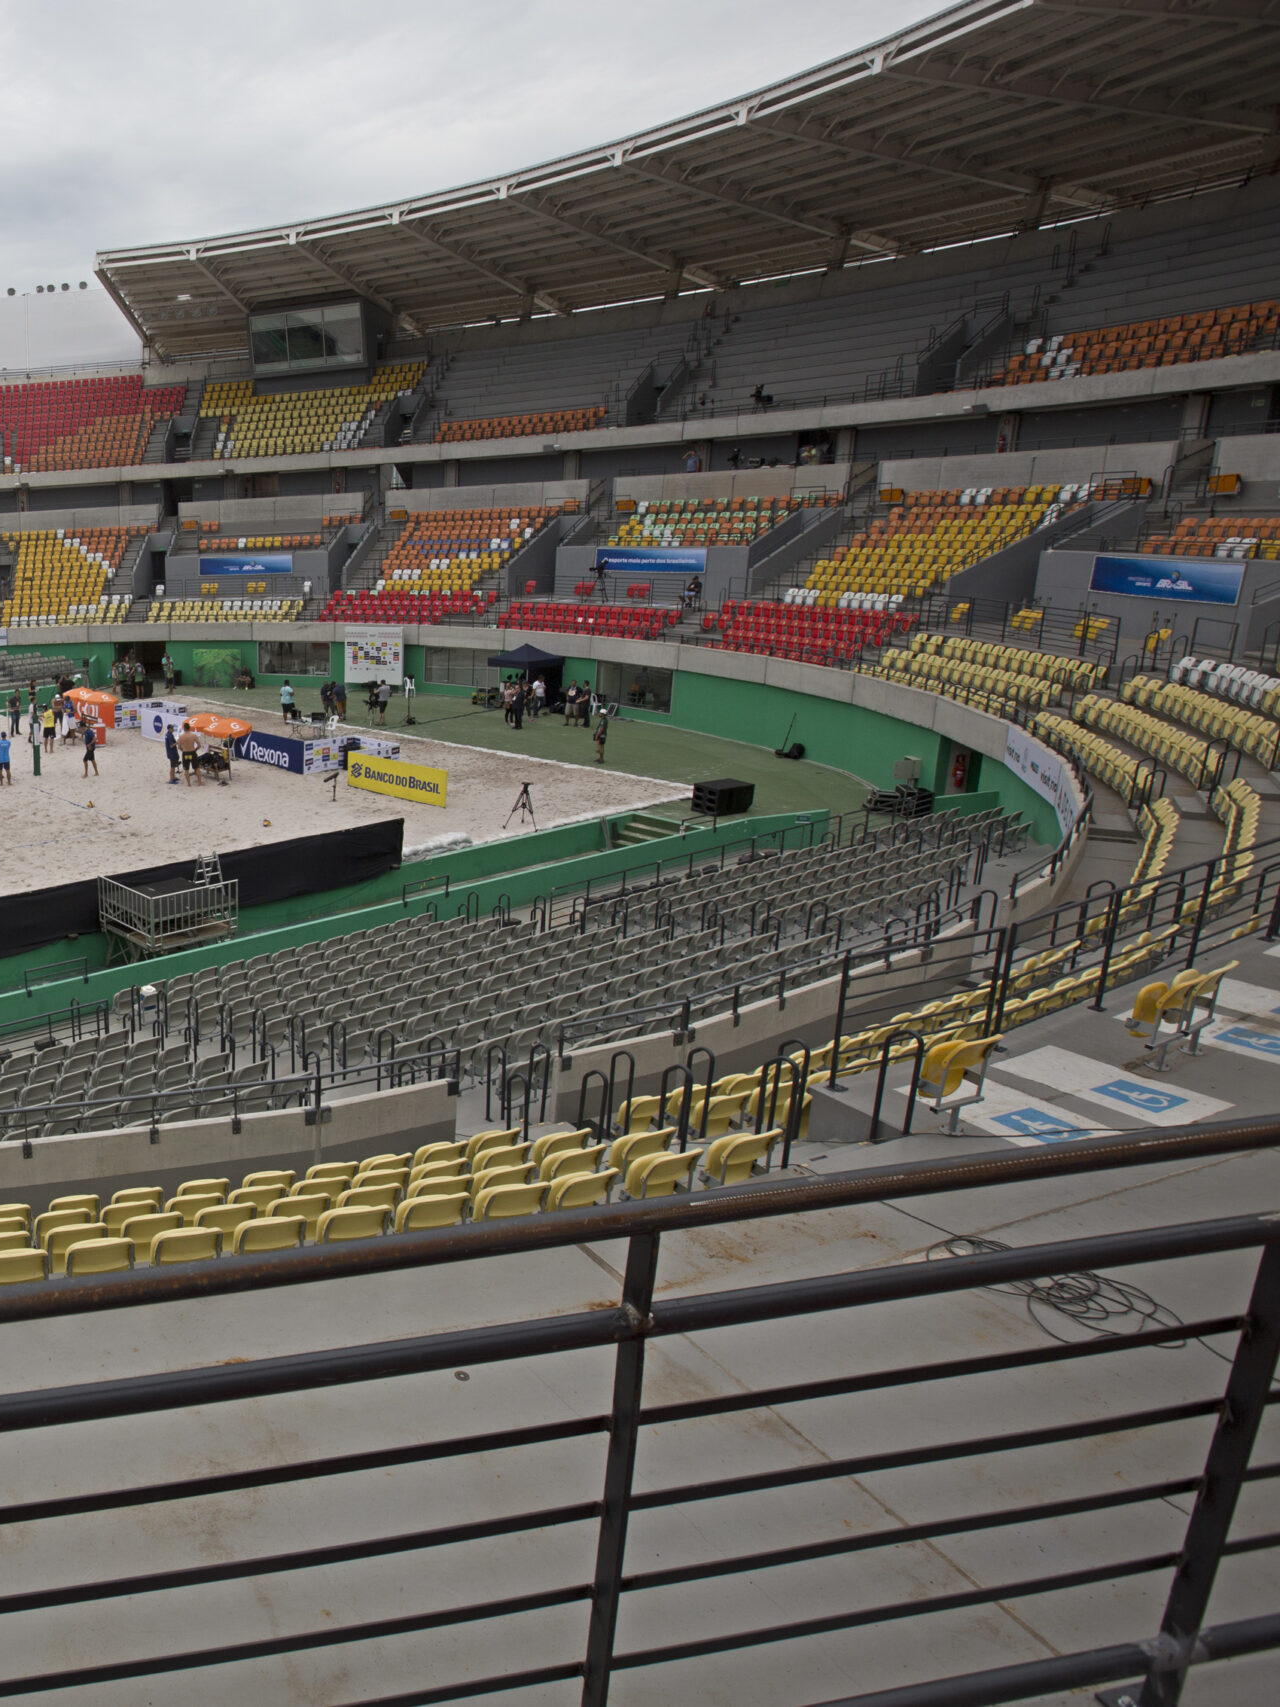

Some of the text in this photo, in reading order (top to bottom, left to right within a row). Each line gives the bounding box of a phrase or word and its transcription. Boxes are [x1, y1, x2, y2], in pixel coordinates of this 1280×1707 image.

[250, 741, 289, 768] Rexona
[364, 766, 441, 795] BANCO DO BRASIL
